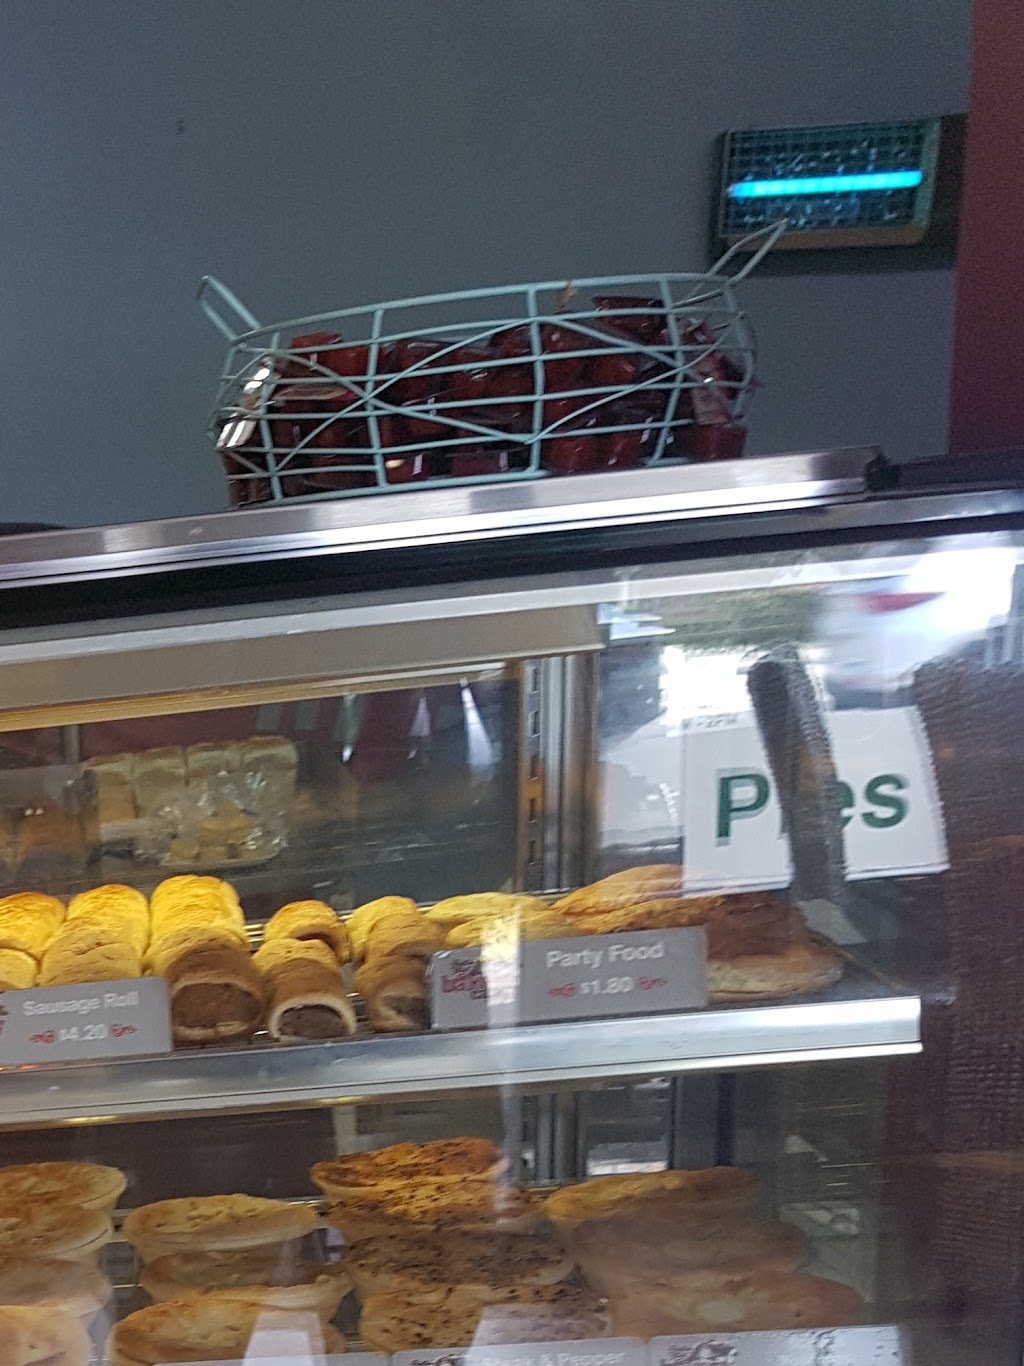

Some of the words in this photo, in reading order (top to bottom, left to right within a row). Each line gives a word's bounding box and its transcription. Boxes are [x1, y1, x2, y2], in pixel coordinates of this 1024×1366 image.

[716, 768, 908, 846] Ps
[546, 948, 603, 969] Party
[608, 941, 665, 963] Food
[578, 976, 633, 996] $1.80
[22, 998, 101, 1016] Sausage
[102, 990, 140, 1009] Roll
[58, 1024, 108, 1042] $4.20
